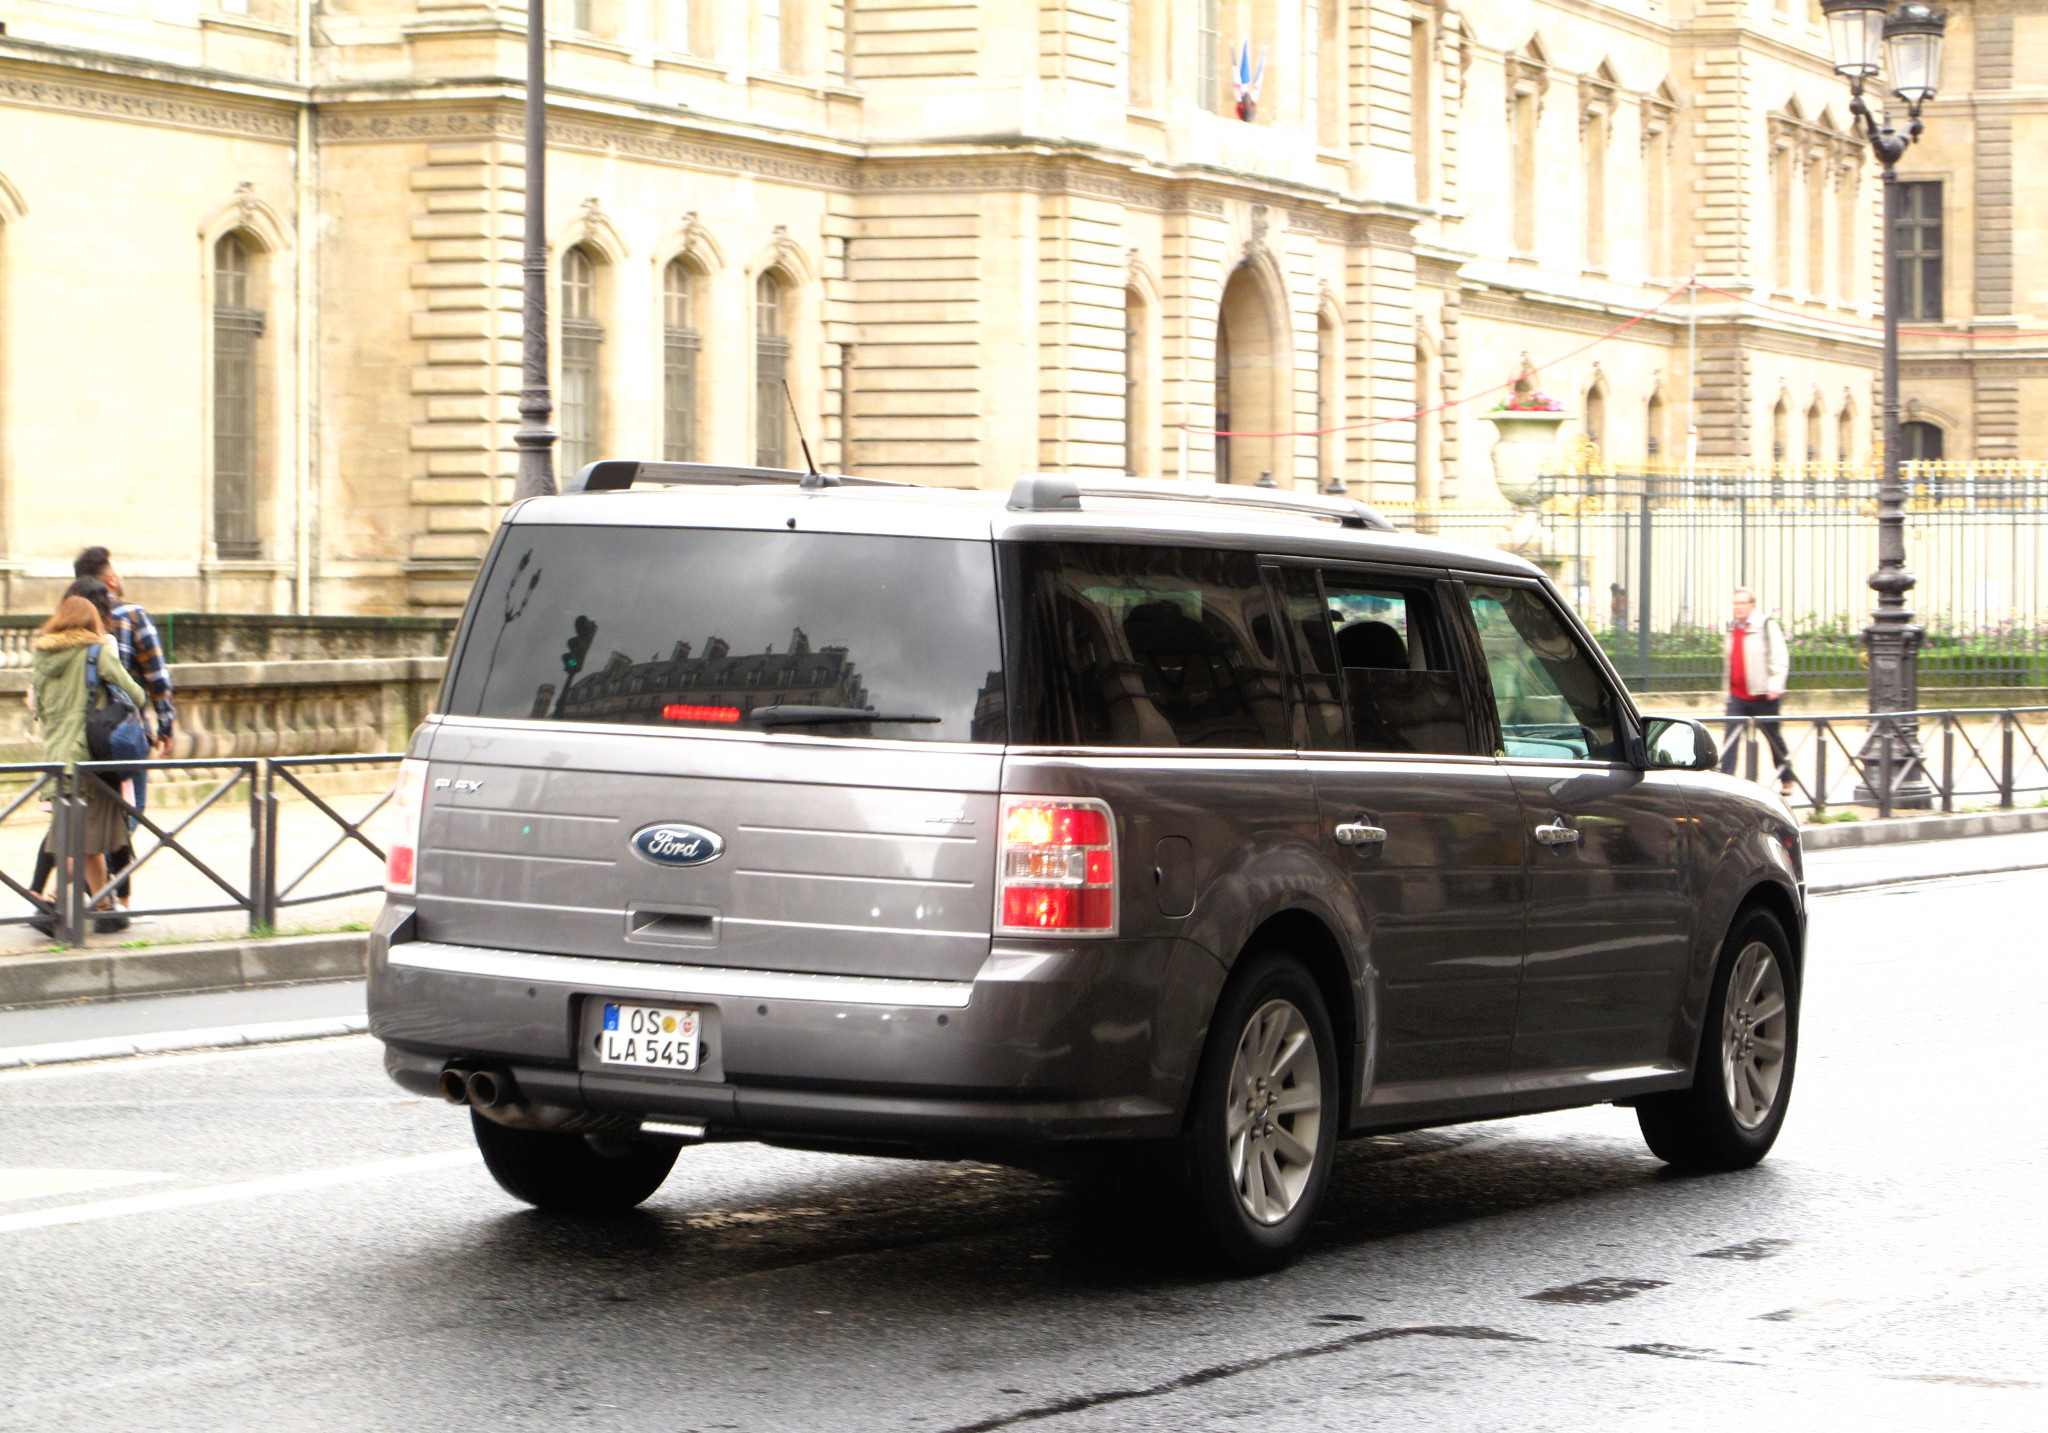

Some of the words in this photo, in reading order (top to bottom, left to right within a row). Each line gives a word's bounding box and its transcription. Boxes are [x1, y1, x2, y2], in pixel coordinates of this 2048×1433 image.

[648, 829, 701, 857] Ford
[631, 1009, 660, 1035] OS
[608, 1036, 636, 1062] LA
[646, 1039, 690, 1066] 545
